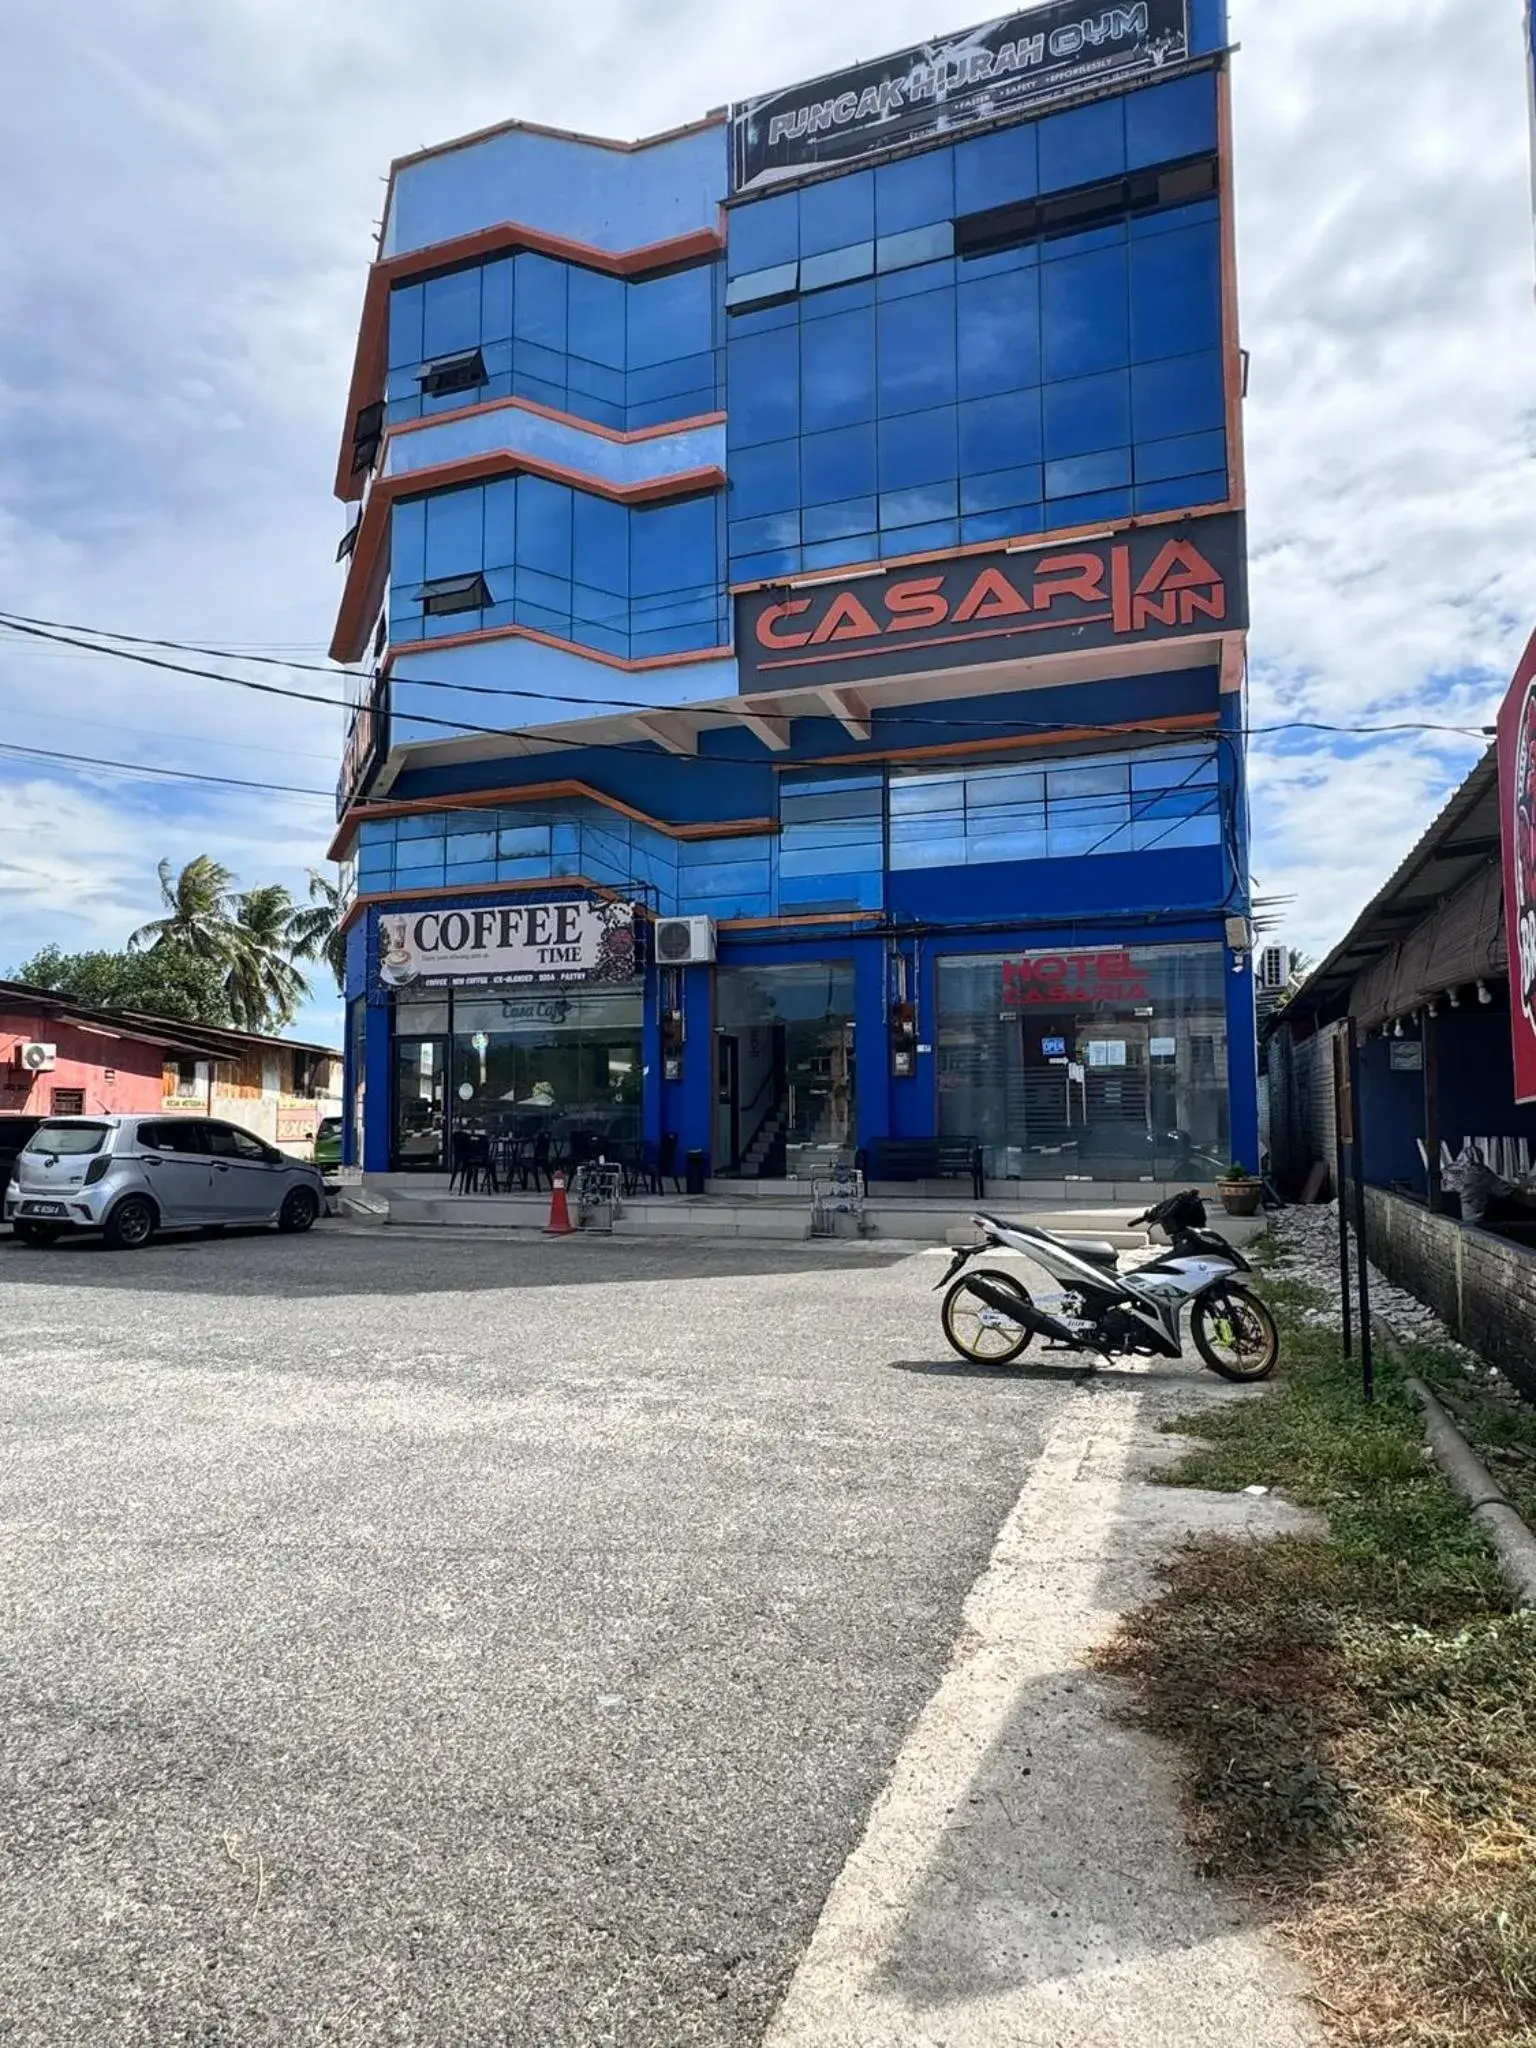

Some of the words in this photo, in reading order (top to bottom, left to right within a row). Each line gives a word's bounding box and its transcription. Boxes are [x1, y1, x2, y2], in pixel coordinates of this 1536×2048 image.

[768, 77, 905, 145] PUNCAK
[909, 33, 1045, 102] HIJRAH
[1049, 1, 1148, 57] GYM
[1004, 80, 1037, 97] SAFETY
[755, 538, 1224, 650] CASARIA
[413, 905, 583, 952] COFFEE
[536, 947, 582, 964] TIME
[1002, 952, 1149, 984] HOTEL
